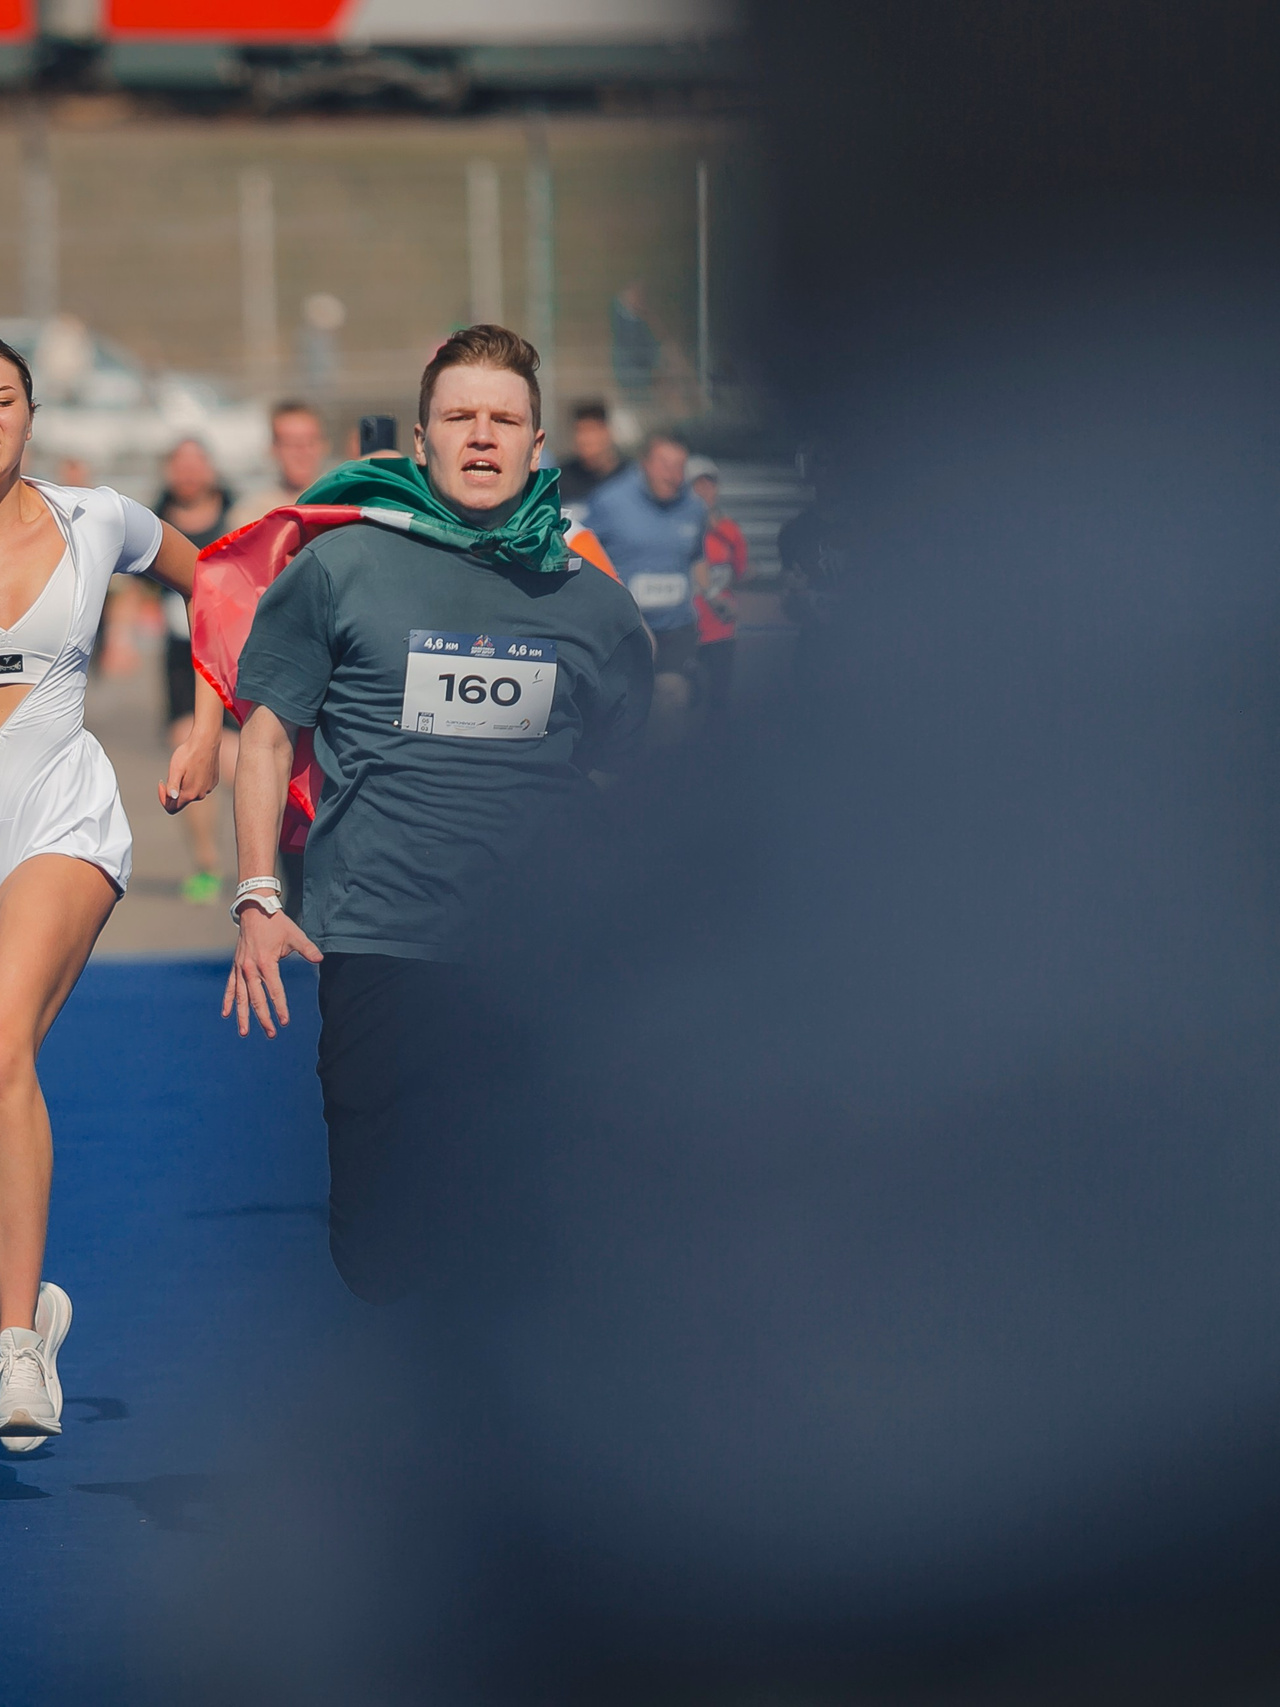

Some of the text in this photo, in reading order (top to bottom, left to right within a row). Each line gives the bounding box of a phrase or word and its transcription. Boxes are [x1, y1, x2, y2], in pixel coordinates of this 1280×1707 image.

[423, 637, 444, 651] 4,6
[507, 644, 527, 657] 4,6
[438, 673, 522, 707] 160
